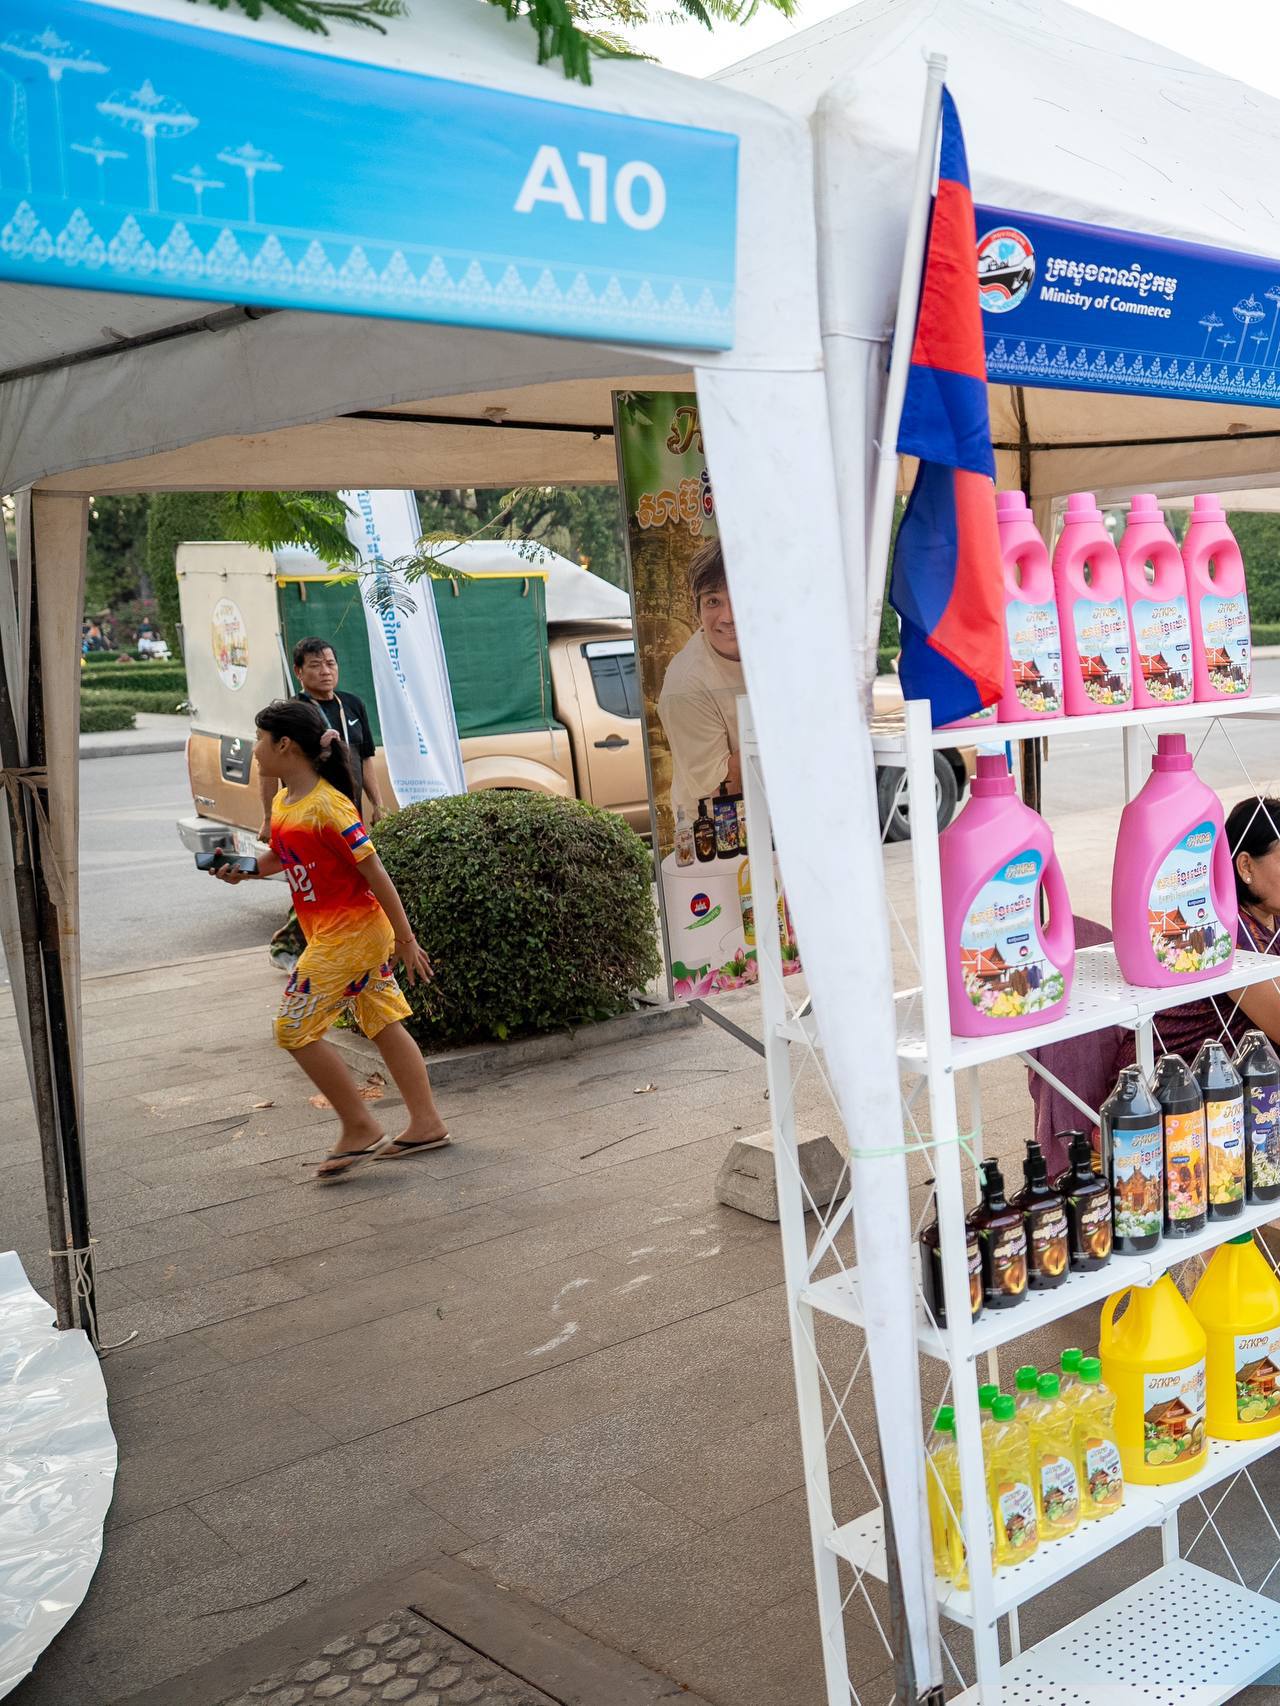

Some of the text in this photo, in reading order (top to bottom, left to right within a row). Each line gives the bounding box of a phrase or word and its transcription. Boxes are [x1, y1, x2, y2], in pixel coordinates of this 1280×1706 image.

[513, 144, 667, 232] A10
[1044, 256, 1178, 302] ក្រសួងពាណិជ្ជកម្ម
[1039, 285, 1172, 319] Ministry of Commerce
[1238, 1335, 1270, 1350] KKPO
[1148, 1375, 1182, 1390] KKPO
